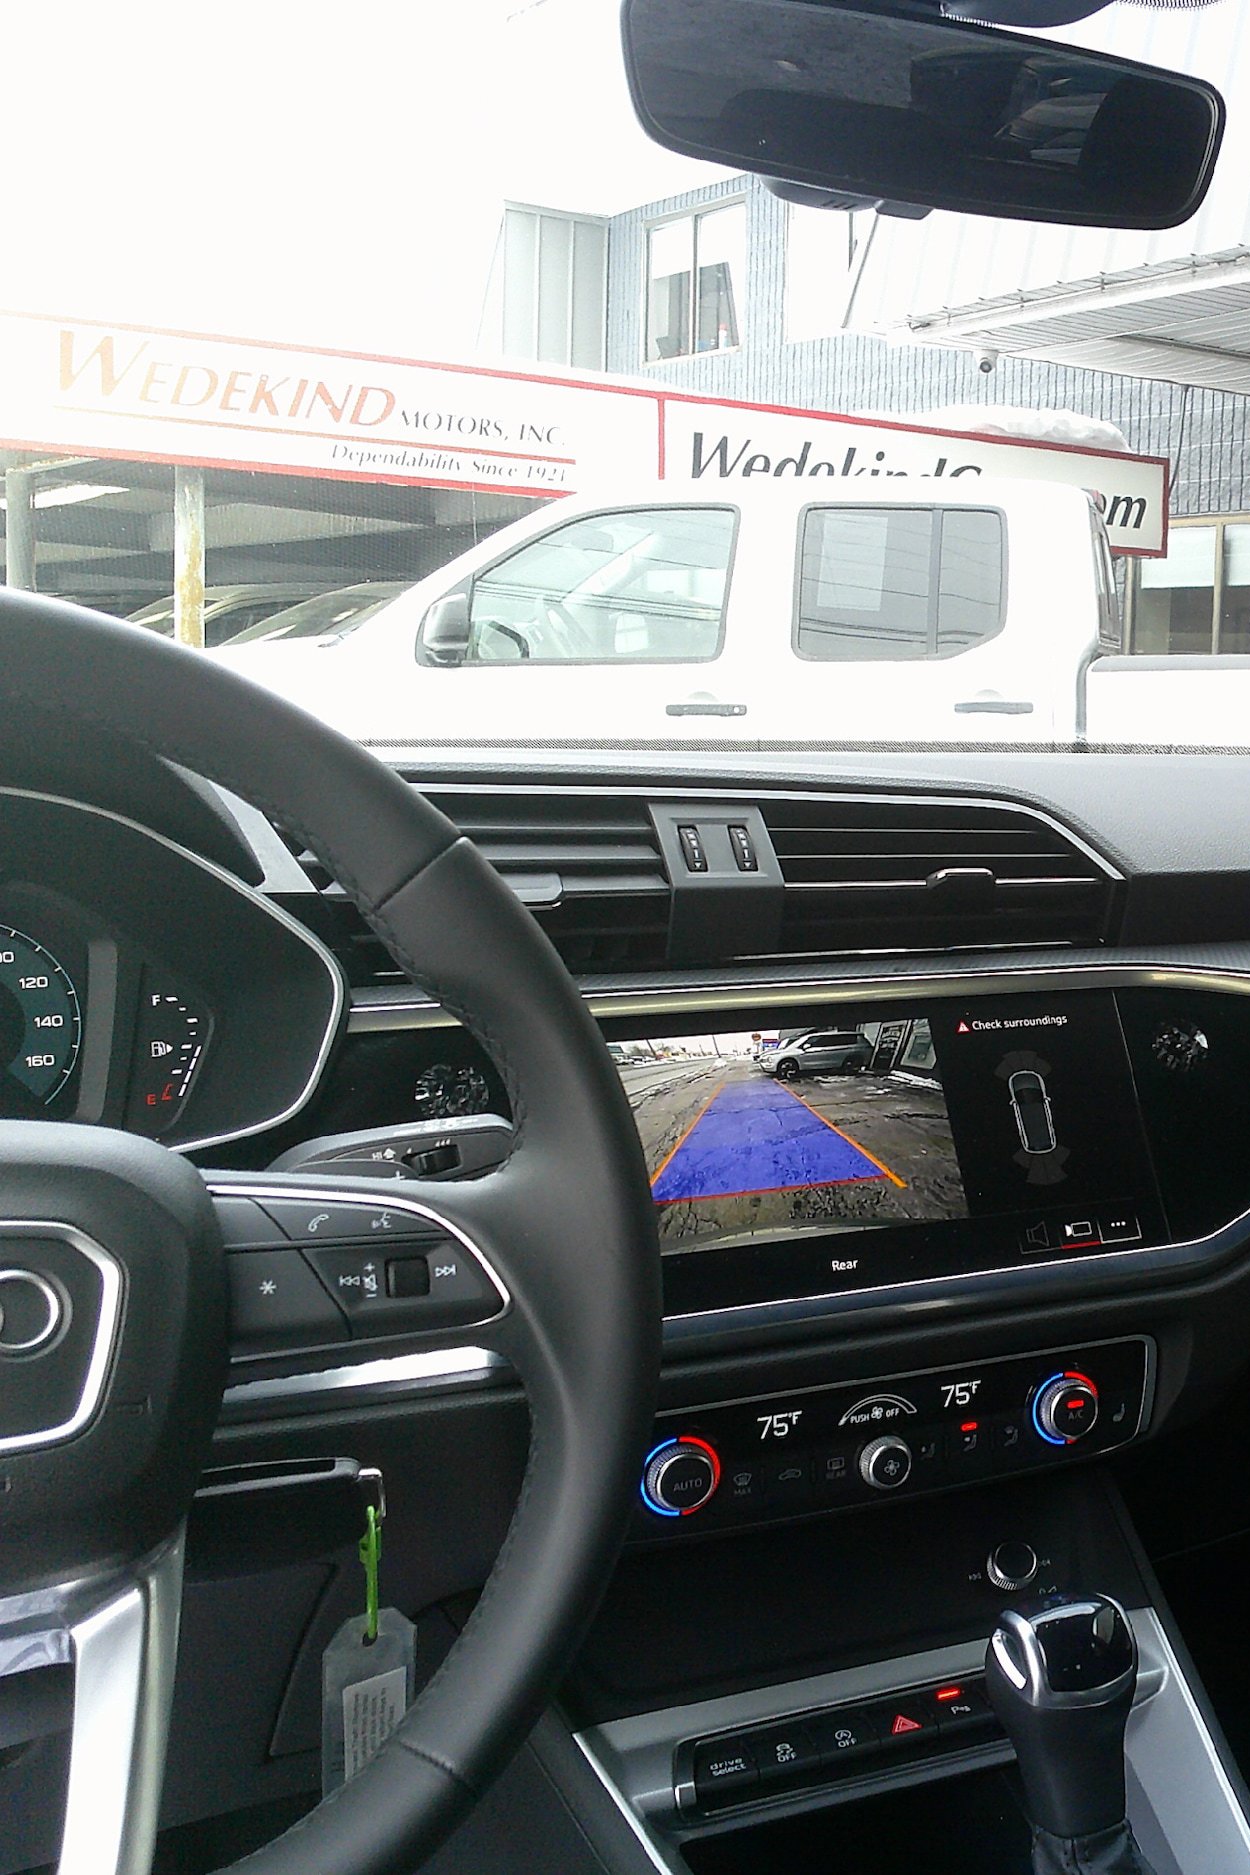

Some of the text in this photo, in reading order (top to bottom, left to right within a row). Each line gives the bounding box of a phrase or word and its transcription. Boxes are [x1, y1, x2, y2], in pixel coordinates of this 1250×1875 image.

[332, 444, 460, 471] Dependability
[472, 459, 517, 477] Since
[18, 976, 49, 989] 120
[152, 994, 161, 1006] F
[33, 1015, 63, 1028] 140
[972, 1015, 1067, 1030] Check surroundings
[25, 1054, 55, 1068] 160
[146, 1094, 156, 1105] E
[831, 1258, 858, 1271] Rear
[850, 1407, 899, 1425] PUSH OFF
[757, 1410, 802, 1440] 75°F
[673, 1478, 703, 1493] AUTO
[838, 1737, 857, 1748] OFF
[709, 1757, 744, 1771] drive
[777, 1751, 797, 1763] OFF
[712, 1762, 747, 1777] select
